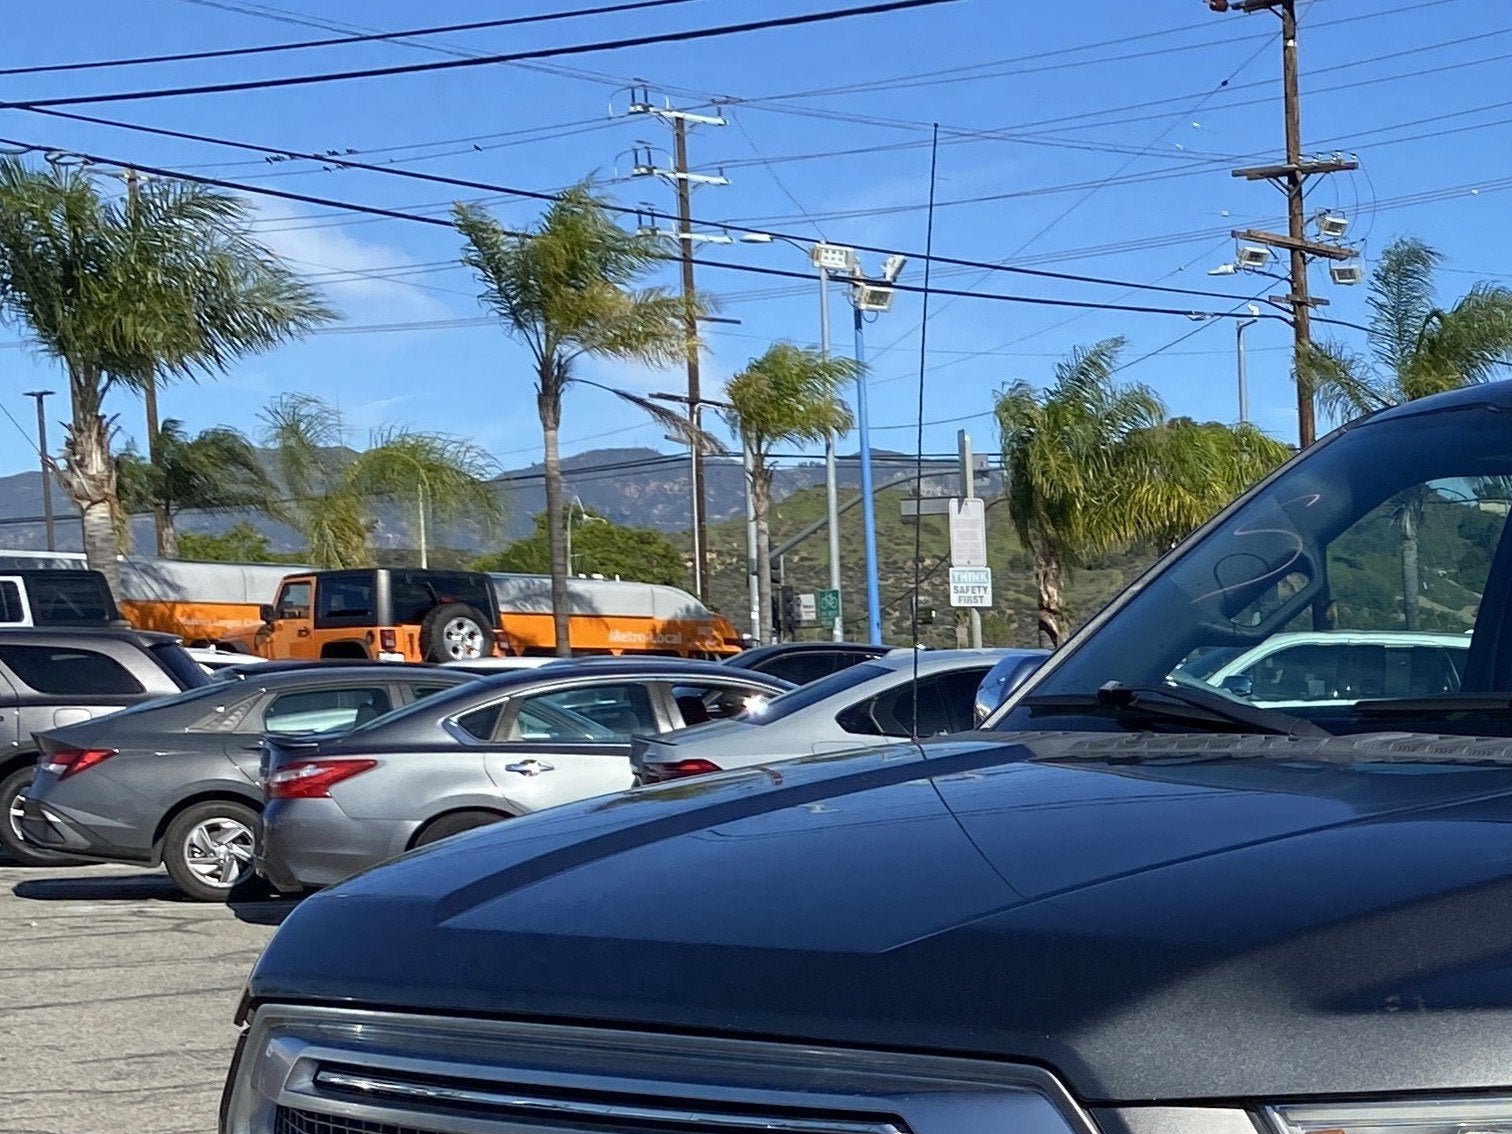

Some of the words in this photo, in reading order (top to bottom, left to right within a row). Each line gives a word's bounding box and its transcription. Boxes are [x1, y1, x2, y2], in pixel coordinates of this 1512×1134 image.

[952, 571, 988, 583] THINK
[953, 585, 988, 595] SAFETY
[958, 595, 985, 604] FIRST
[608, 629, 646, 643] Metro
[649, 632, 682, 644] Local
